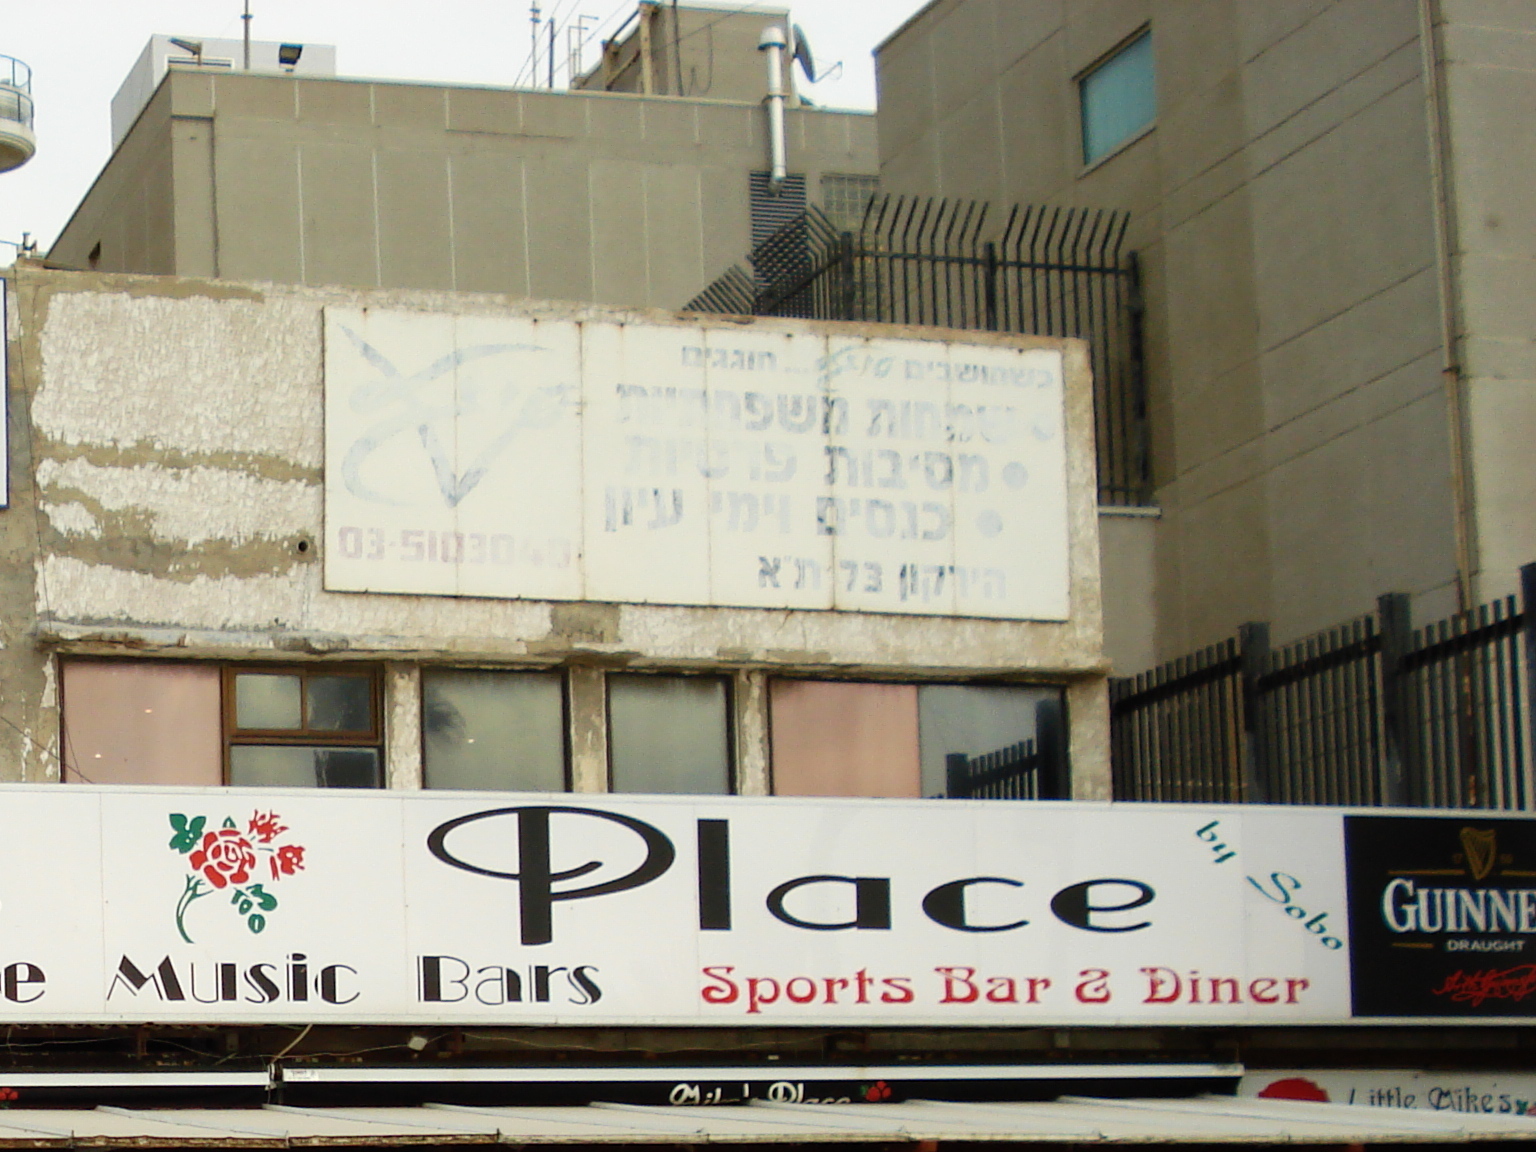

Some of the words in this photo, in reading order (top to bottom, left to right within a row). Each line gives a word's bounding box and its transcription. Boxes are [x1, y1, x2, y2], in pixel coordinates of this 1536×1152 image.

[823, 444, 990, 493] מסיבות
[816, 496, 952, 541] כנסים
[1196, 820, 1236, 864] by
[426, 806, 1157, 946] Place
[1446, 939, 1525, 952] DRAUGHT
[107, 951, 362, 1005] Music
[416, 955, 603, 1006] Bars
[700, 965, 915, 1015] Sports
[934, 966, 1052, 1004] Bar
[1139, 966, 1311, 1005] Diner
